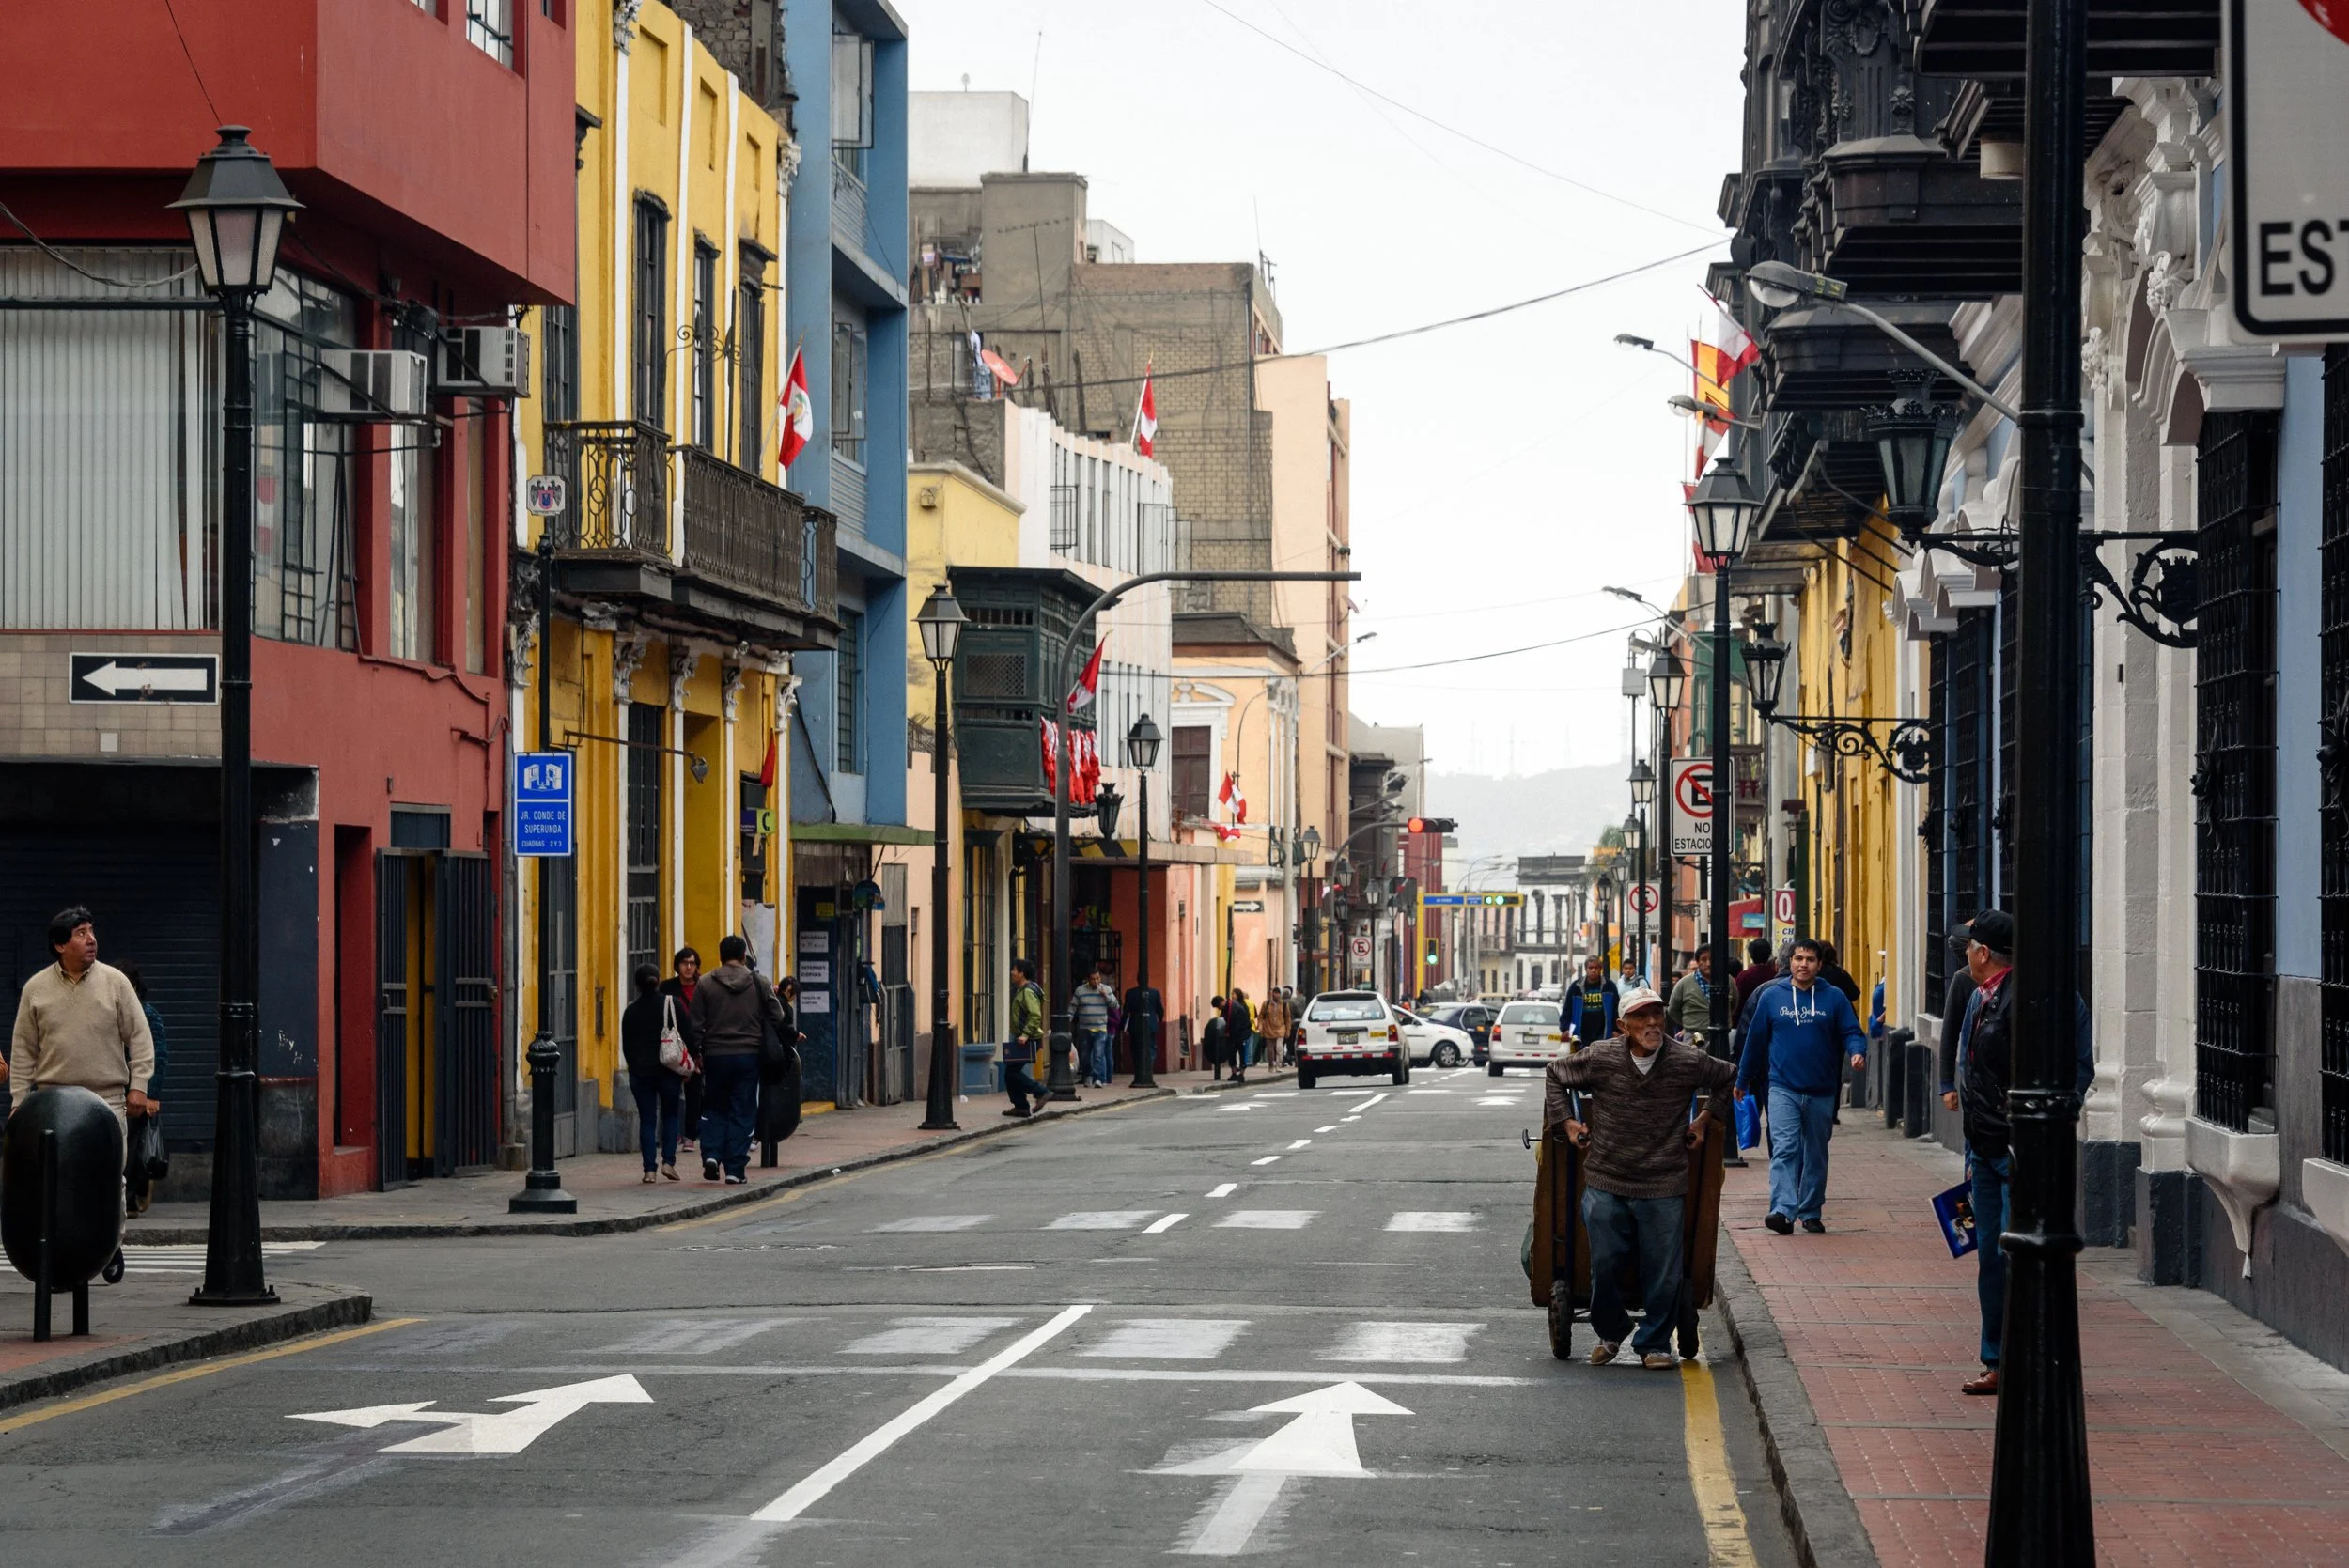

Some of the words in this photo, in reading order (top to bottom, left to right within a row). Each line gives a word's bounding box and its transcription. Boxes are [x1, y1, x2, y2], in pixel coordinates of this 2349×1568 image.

[533, 811, 554, 820] CONDE
[557, 811, 566, 820] DE
[524, 825, 562, 834] SUPERUNDA
[1694, 822, 1711, 833] NO
[1675, 838, 1713, 849] ESTACIO
